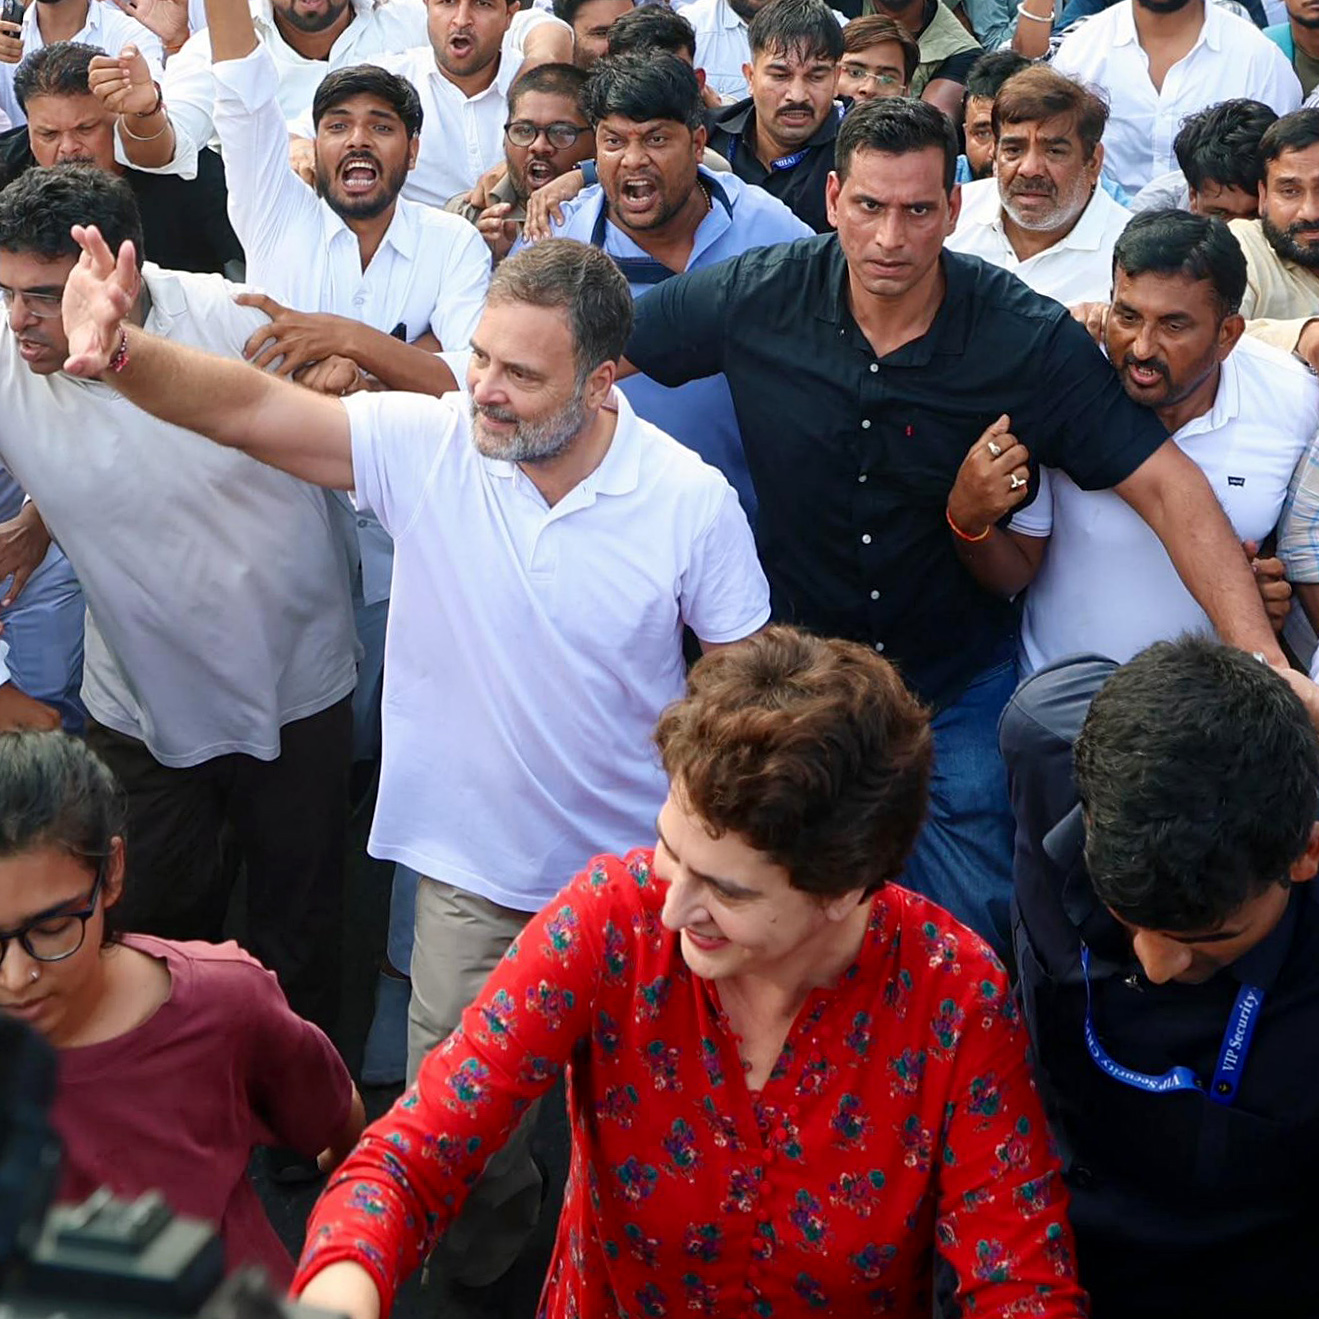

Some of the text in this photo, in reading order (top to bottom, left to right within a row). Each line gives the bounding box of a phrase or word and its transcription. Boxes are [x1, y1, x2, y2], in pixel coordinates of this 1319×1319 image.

[1222, 991, 1259, 1073] VIP Security
[1100, 1060, 1159, 1089] Security
[1159, 1074, 1181, 1091] VIP
